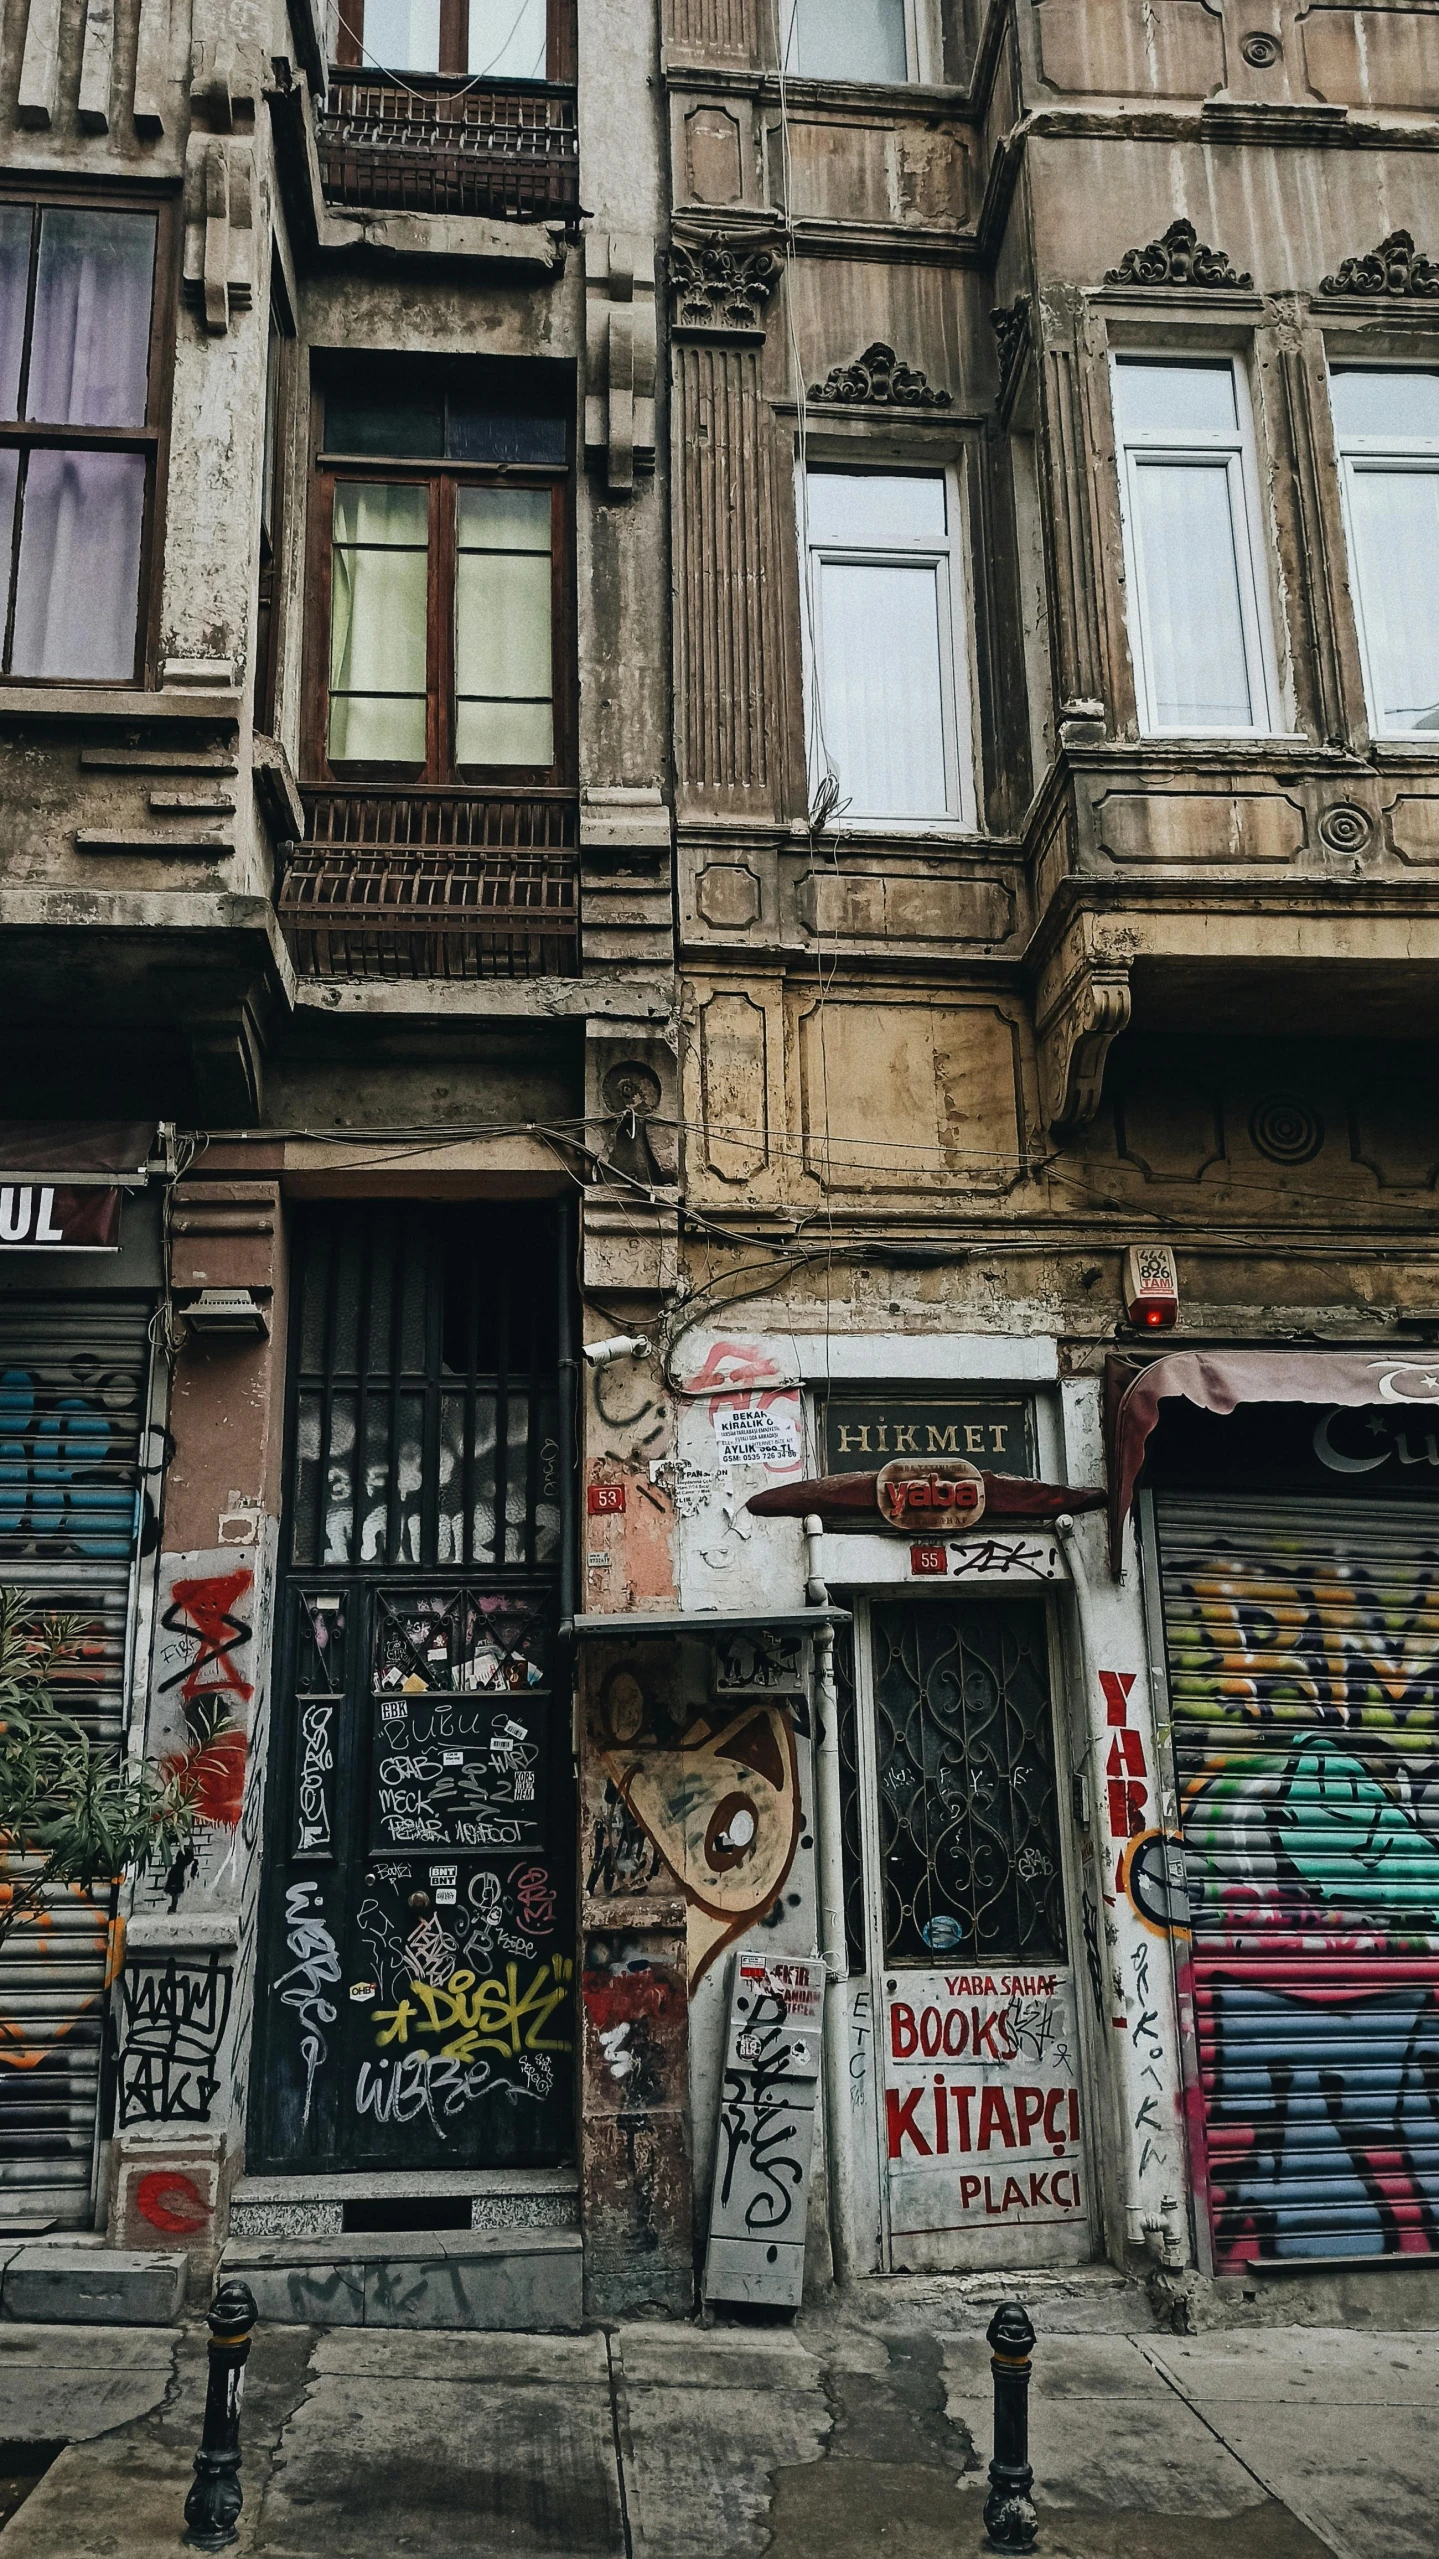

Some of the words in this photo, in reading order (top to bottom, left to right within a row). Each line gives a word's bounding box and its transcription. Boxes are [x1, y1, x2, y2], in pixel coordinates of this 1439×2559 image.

[1140, 1250, 1167, 1262] 444
[1141, 1265, 1170, 1278] 826
[1142, 1279, 1171, 1288] TAM
[722, 1420, 763, 1431] KİRALIK
[837, 1416, 1009, 1452] HİKMET
[724, 1445, 756, 1455] AYLIK
[723, 1455, 741, 1463] GSM:
[599, 1491, 617, 1507] 53
[884, 1473, 978, 1516] yaba
[921, 1552, 938, 1568] 55
[431, 1867, 455, 1876] BNT
[431, 1876, 455, 1885] BNT
[944, 1976, 998, 1996] YABA
[1000, 1974, 1058, 1996] SAHAF
[890, 2002, 1019, 2060] BOOKS
[886, 2073, 1081, 2160] KİTAPÇI
[960, 2169, 1081, 2214] PLAKÇI
